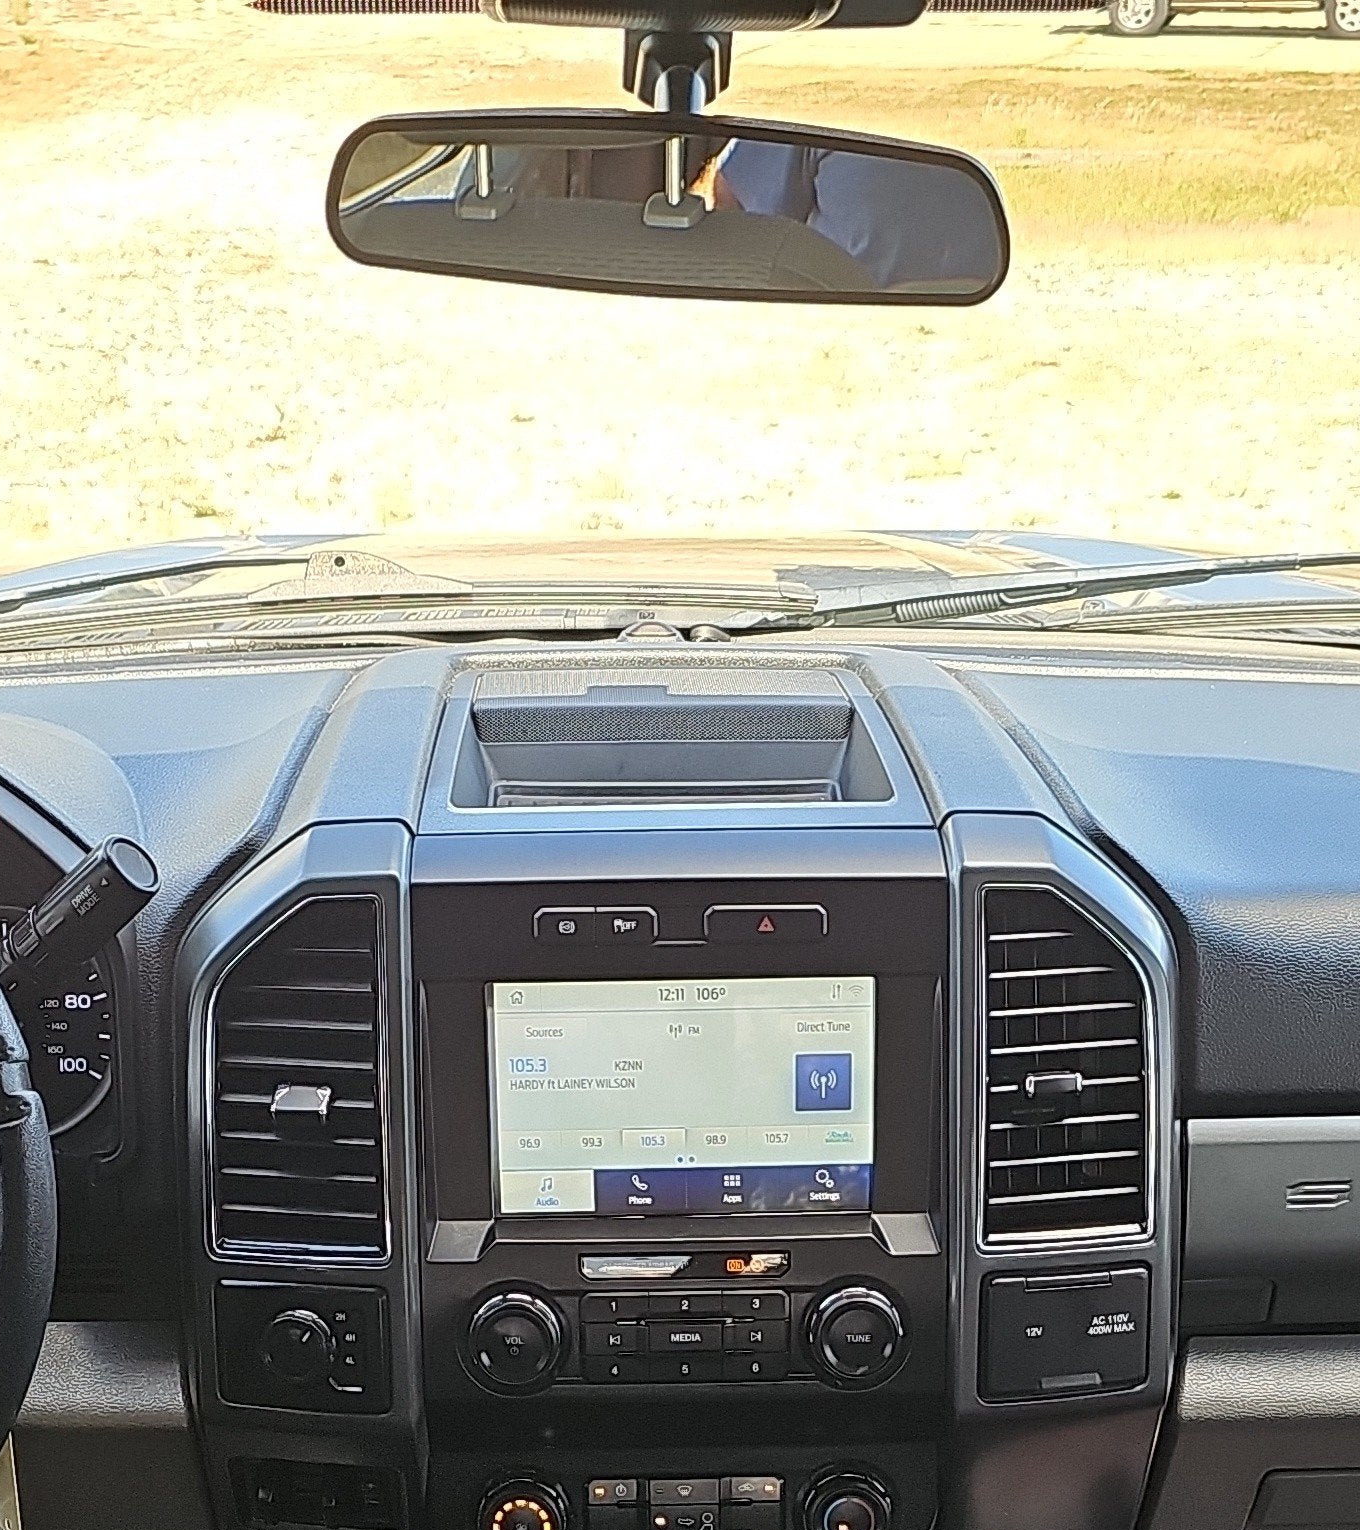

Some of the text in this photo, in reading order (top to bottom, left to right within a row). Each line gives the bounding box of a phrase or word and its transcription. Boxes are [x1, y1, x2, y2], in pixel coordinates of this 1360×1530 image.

[64, 994, 91, 1008] 80
[657, 988, 685, 1002] 12:11
[51, 1022, 68, 1030] 140
[525, 1026, 564, 1038] Sources
[688, 1026, 701, 1035] FM
[796, 1021, 851, 1033] Direct Tune
[59, 1058, 87, 1072] 100
[509, 1058, 547, 1073] 105.3
[614, 1060, 643, 1072] KZNN
[509, 1077, 636, 1091] HARDY ft LAINEY WILSON
[519, 1137, 541, 1149] 96.9
[581, 1137, 603, 1148] 99.3
[640, 1135, 666, 1147] 105.3
[705, 1134, 727, 1145] 98.9
[764, 1132, 789, 1144] 105.7
[536, 1196, 559, 1207] Audio
[628, 1195, 652, 1206] Phone
[722, 1194, 742, 1205] Apps
[809, 1191, 840, 1202] Settings
[610, 1300, 617, 1311] 1
[681, 1299, 689, 1311] 2
[752, 1298, 760, 1310] 3
[1091, 1313, 1130, 1326] AC 110V
[1025, 1326, 1043, 1337] 12V
[1113, 1322, 1135, 1333] MAX
[504, 1335, 525, 1345] VOL
[670, 1332, 701, 1344] MEDIA
[846, 1333, 871, 1344] TUNE
[611, 1364, 618, 1376] 4
[681, 1364, 689, 1375] 5
[752, 1362, 760, 1374] 6
